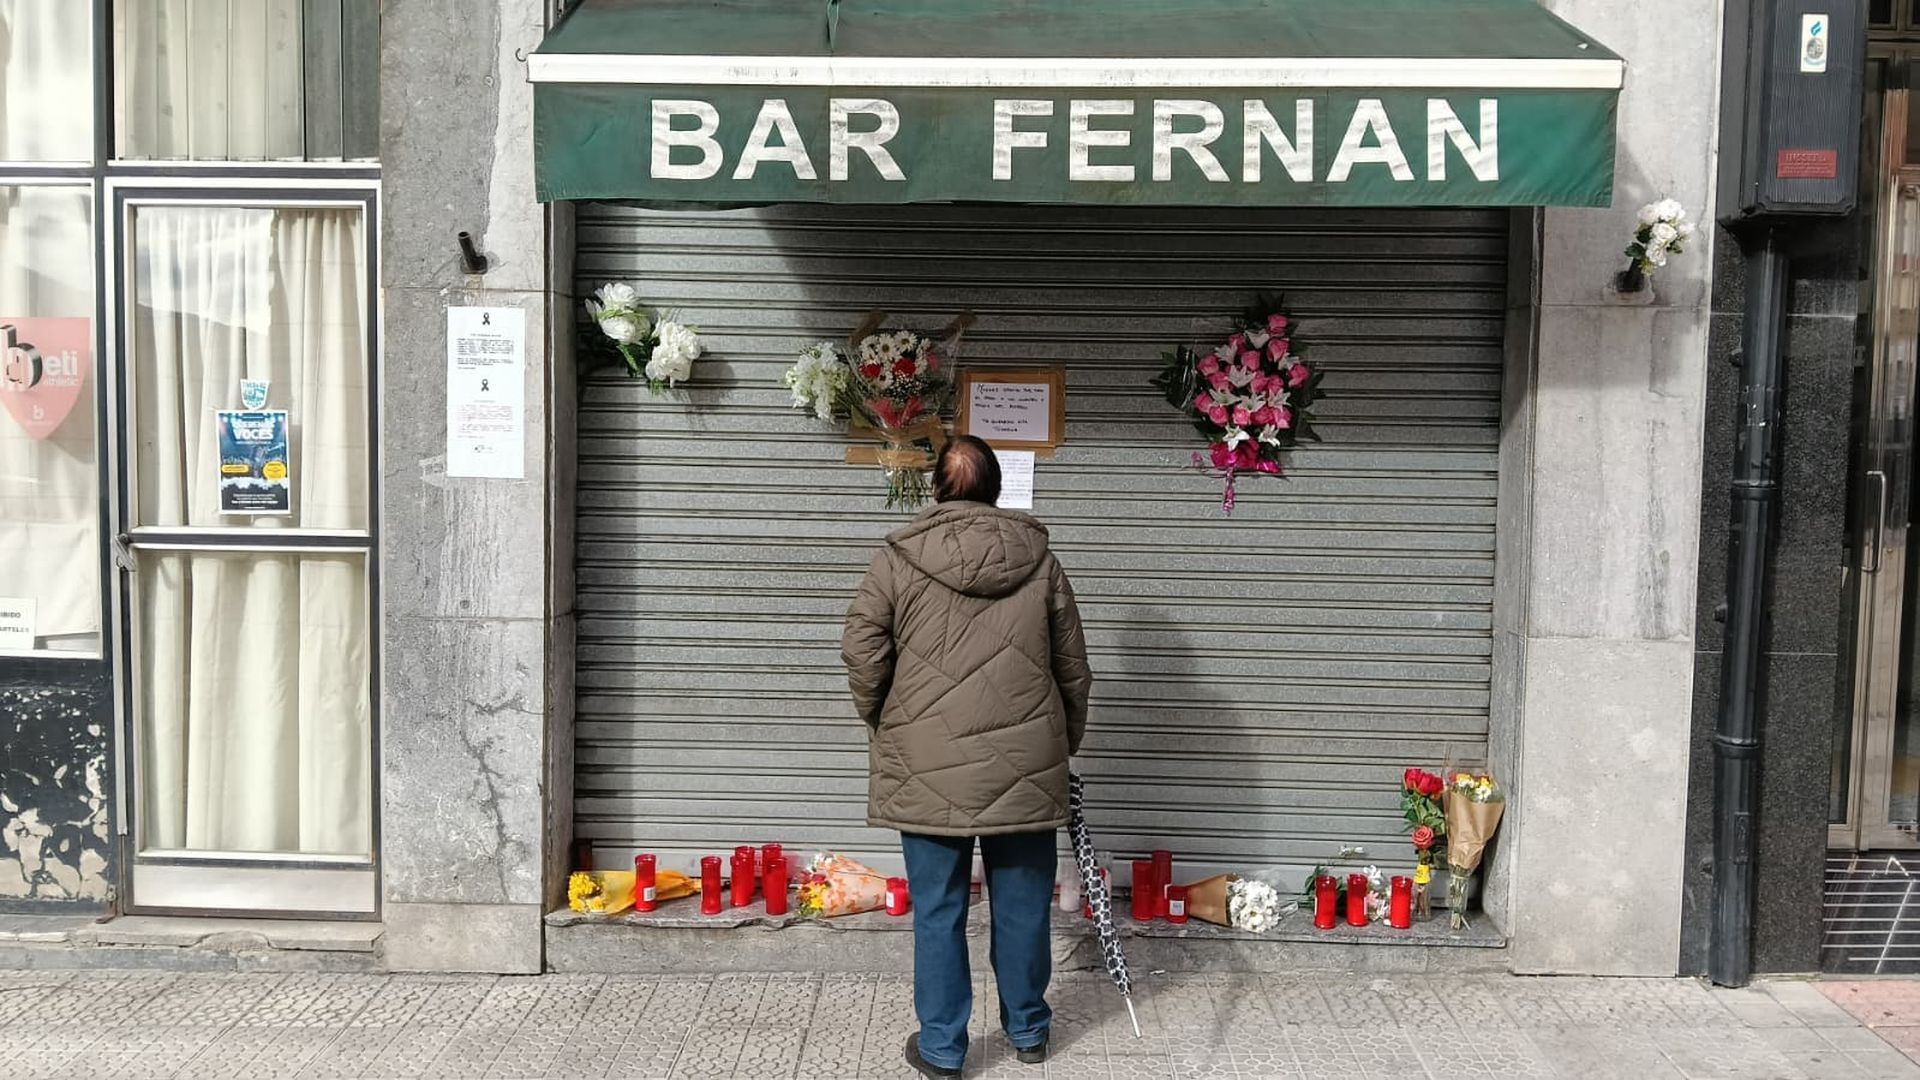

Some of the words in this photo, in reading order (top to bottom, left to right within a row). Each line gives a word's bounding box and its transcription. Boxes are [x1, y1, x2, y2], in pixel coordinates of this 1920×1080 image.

[650, 98, 907, 181] BAR
[991, 98, 1500, 183] FERNAN
[233, 428, 275, 440] VOCES
